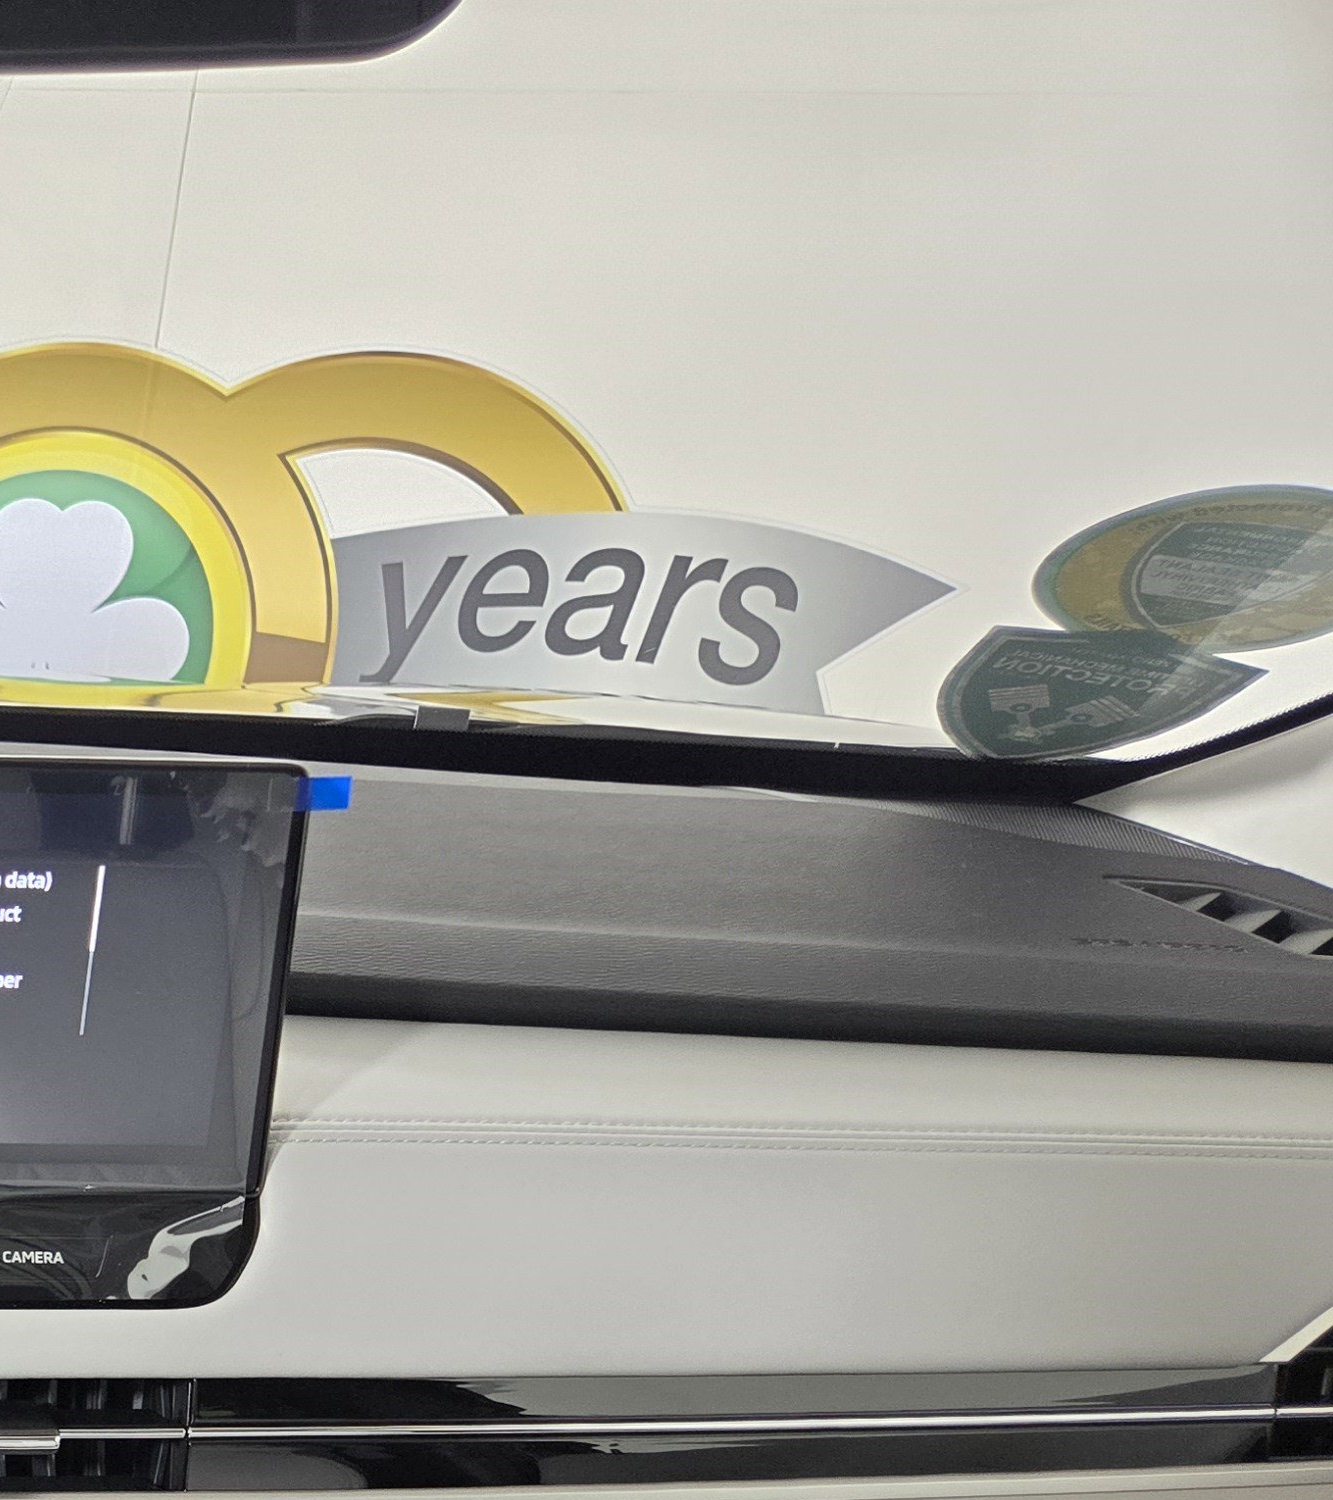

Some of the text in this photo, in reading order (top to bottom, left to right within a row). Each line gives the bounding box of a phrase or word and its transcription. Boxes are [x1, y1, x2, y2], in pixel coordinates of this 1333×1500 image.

[359, 546, 800, 685] years
[5, 871, 53, 891] data)
[2, 1250, 65, 1266] CAMERA
